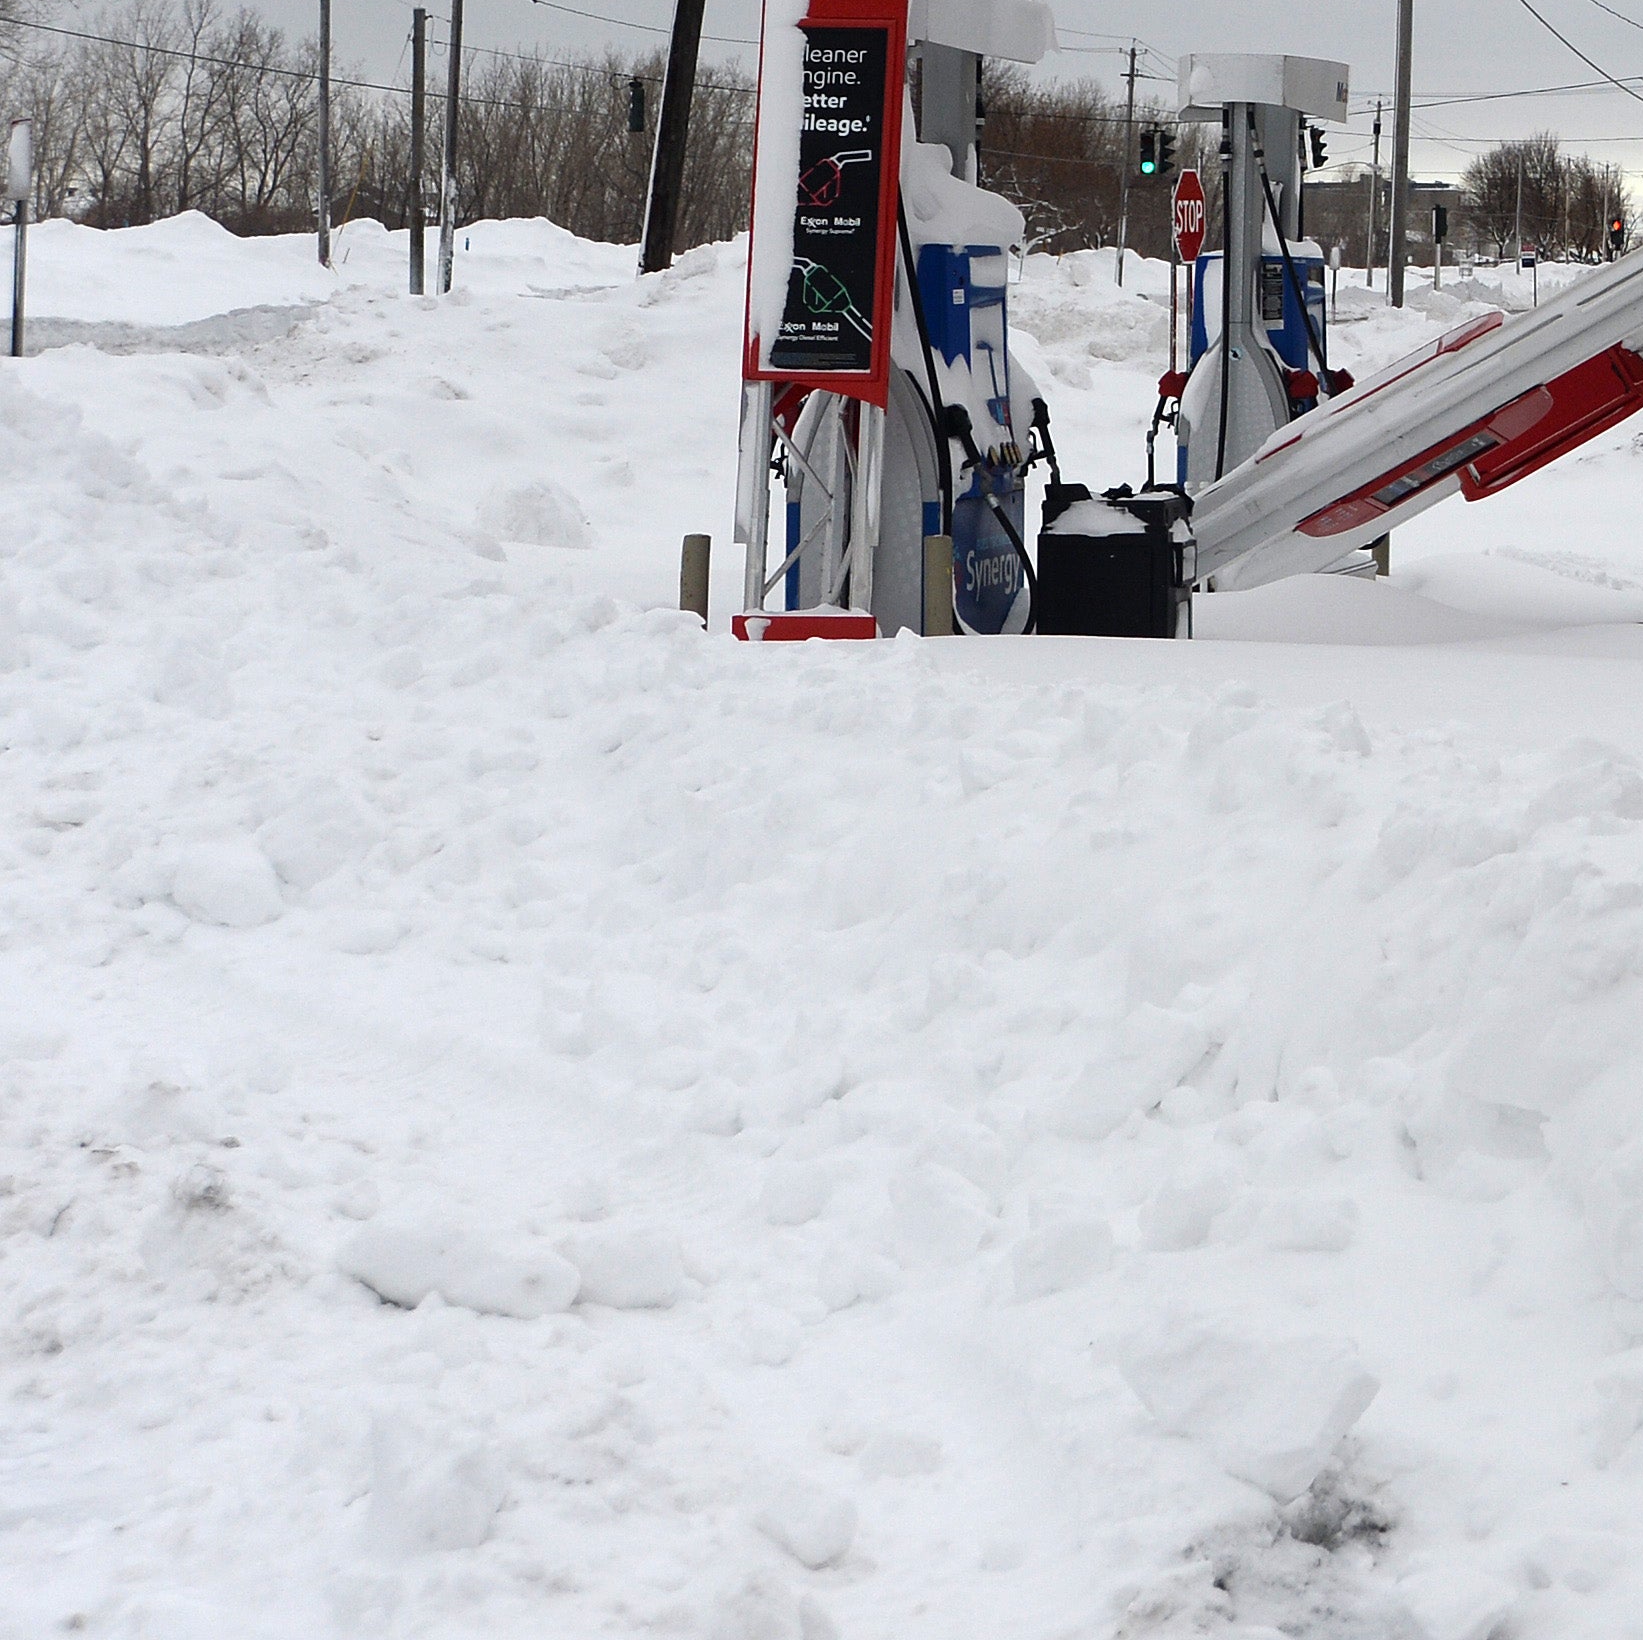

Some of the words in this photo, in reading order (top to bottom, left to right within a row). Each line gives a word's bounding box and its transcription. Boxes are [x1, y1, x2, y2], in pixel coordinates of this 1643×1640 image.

[805, 43, 868, 64] leaner
[803, 66, 862, 90] ngine.
[803, 93, 848, 109] etter
[800, 216, 829, 228] Exxon
[833, 217, 861, 227] Mobil
[1176, 200, 1203, 234] STOP
[811, 321, 839, 331] Mobil
[966, 549, 1021, 602] Synergy
